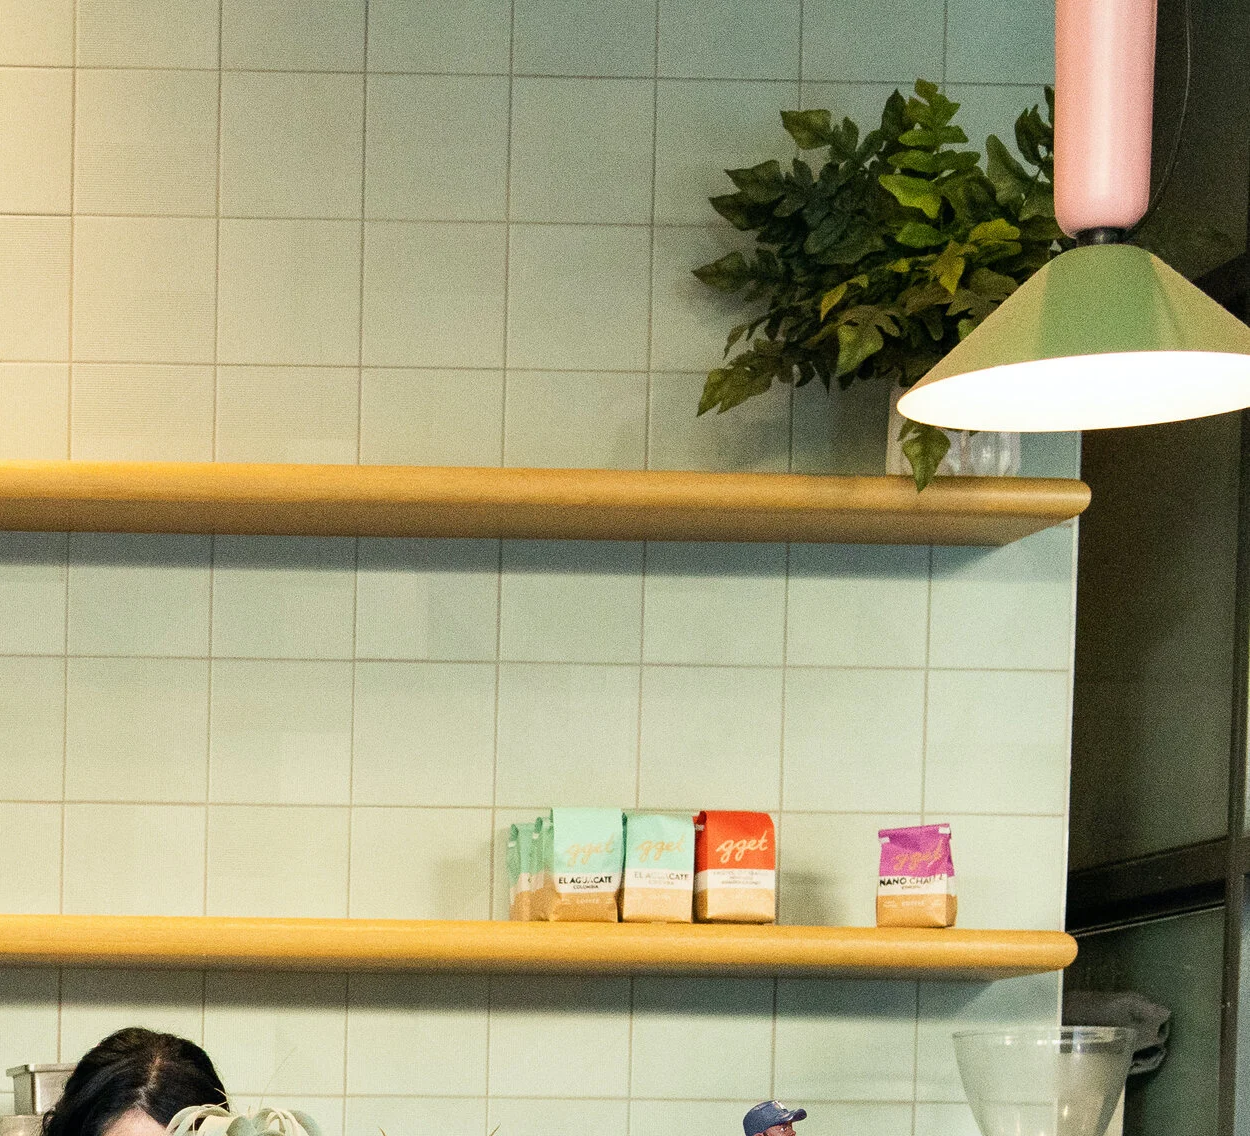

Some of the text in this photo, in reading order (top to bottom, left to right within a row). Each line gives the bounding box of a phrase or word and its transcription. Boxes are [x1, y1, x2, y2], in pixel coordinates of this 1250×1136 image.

[715, 829, 768, 864] gget
[558, 876, 569, 884] EL
[879, 877, 907, 887] NANO
